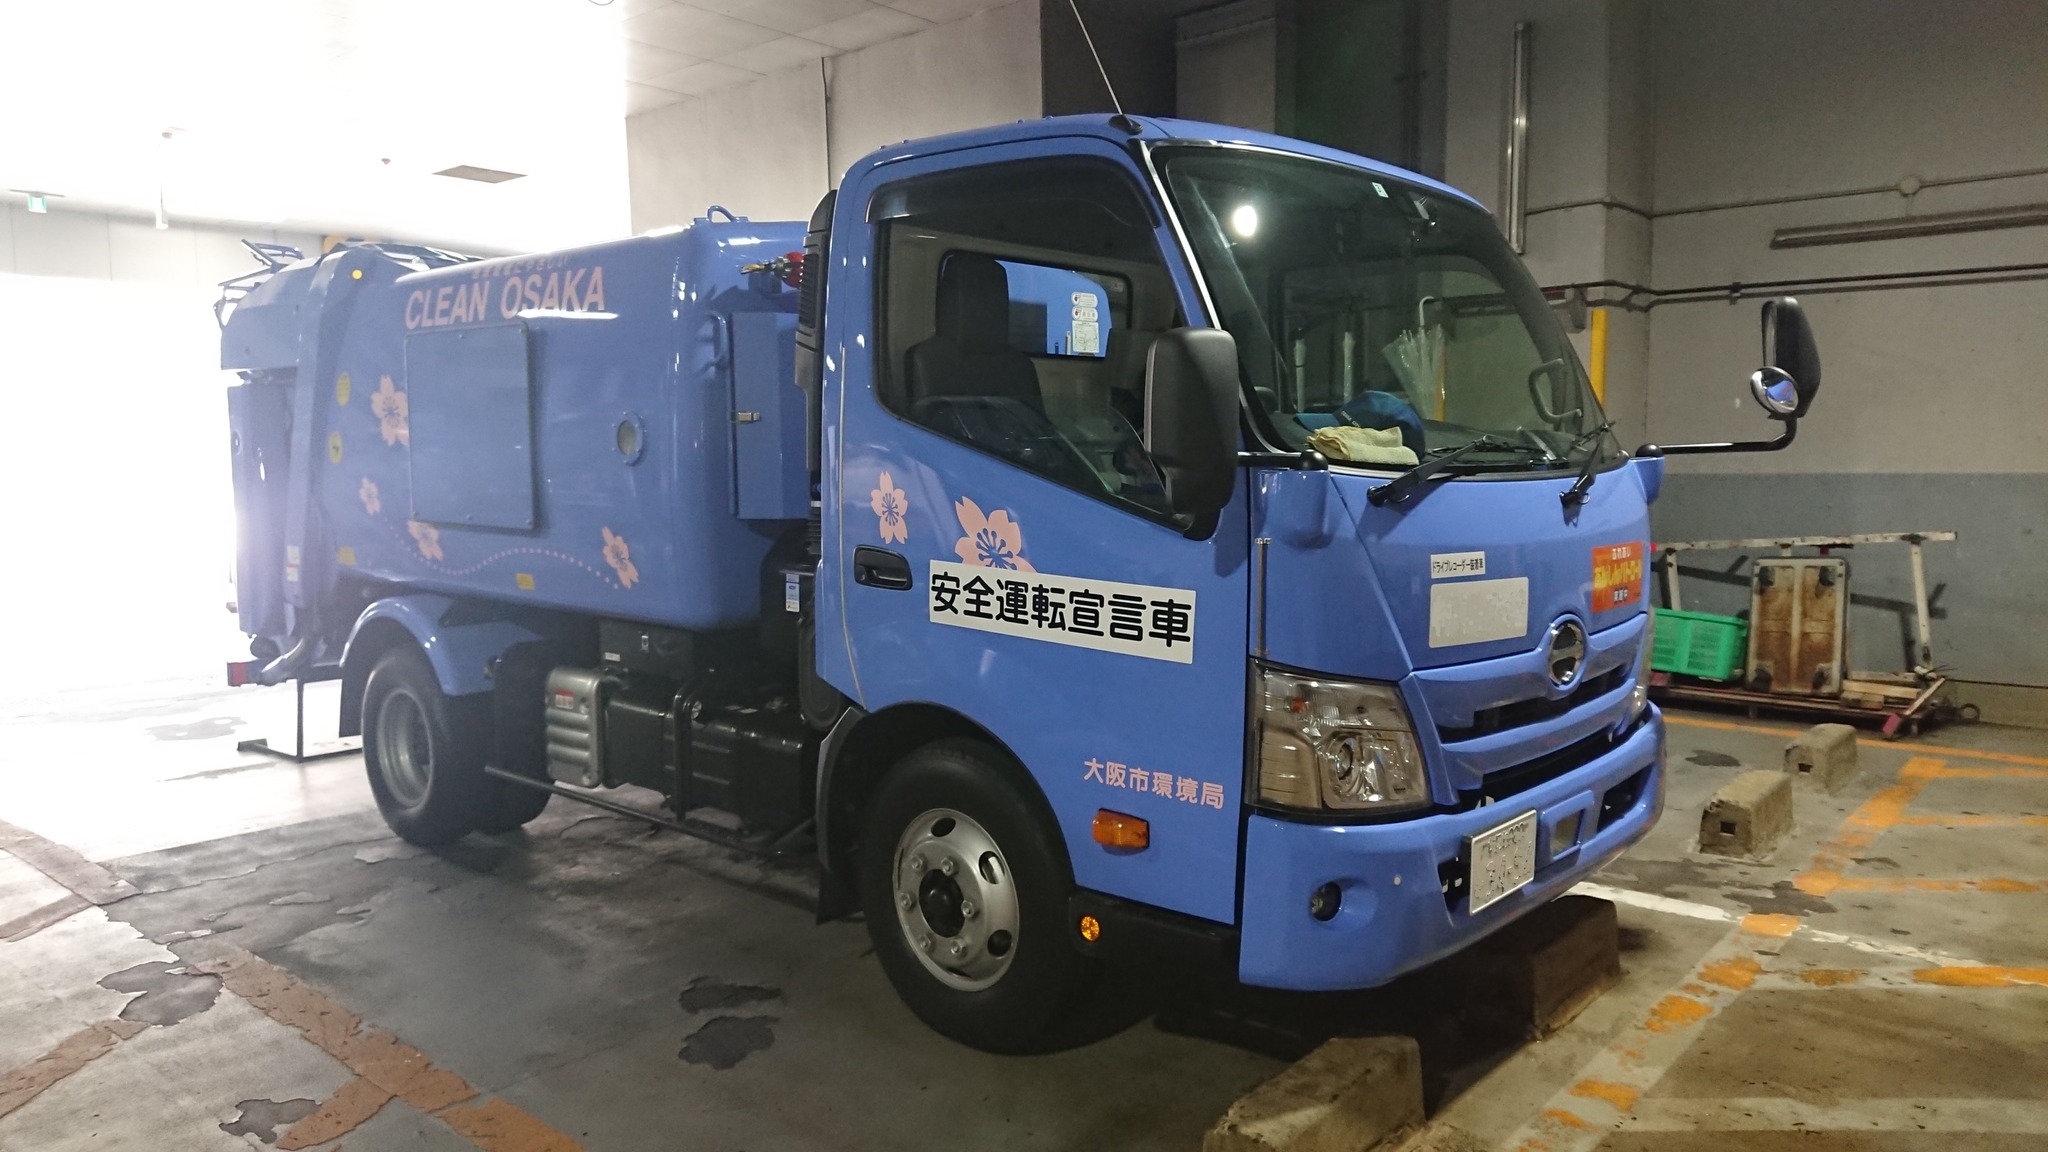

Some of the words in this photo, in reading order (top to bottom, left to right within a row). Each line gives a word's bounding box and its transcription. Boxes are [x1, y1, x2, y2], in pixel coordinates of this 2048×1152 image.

[405, 280, 489, 329] CLEAN
[501, 266, 606, 320] OSAKA
[930, 571, 1193, 648] 安全運転宣言車
[1083, 757, 1225, 810] 大阪市環境局
